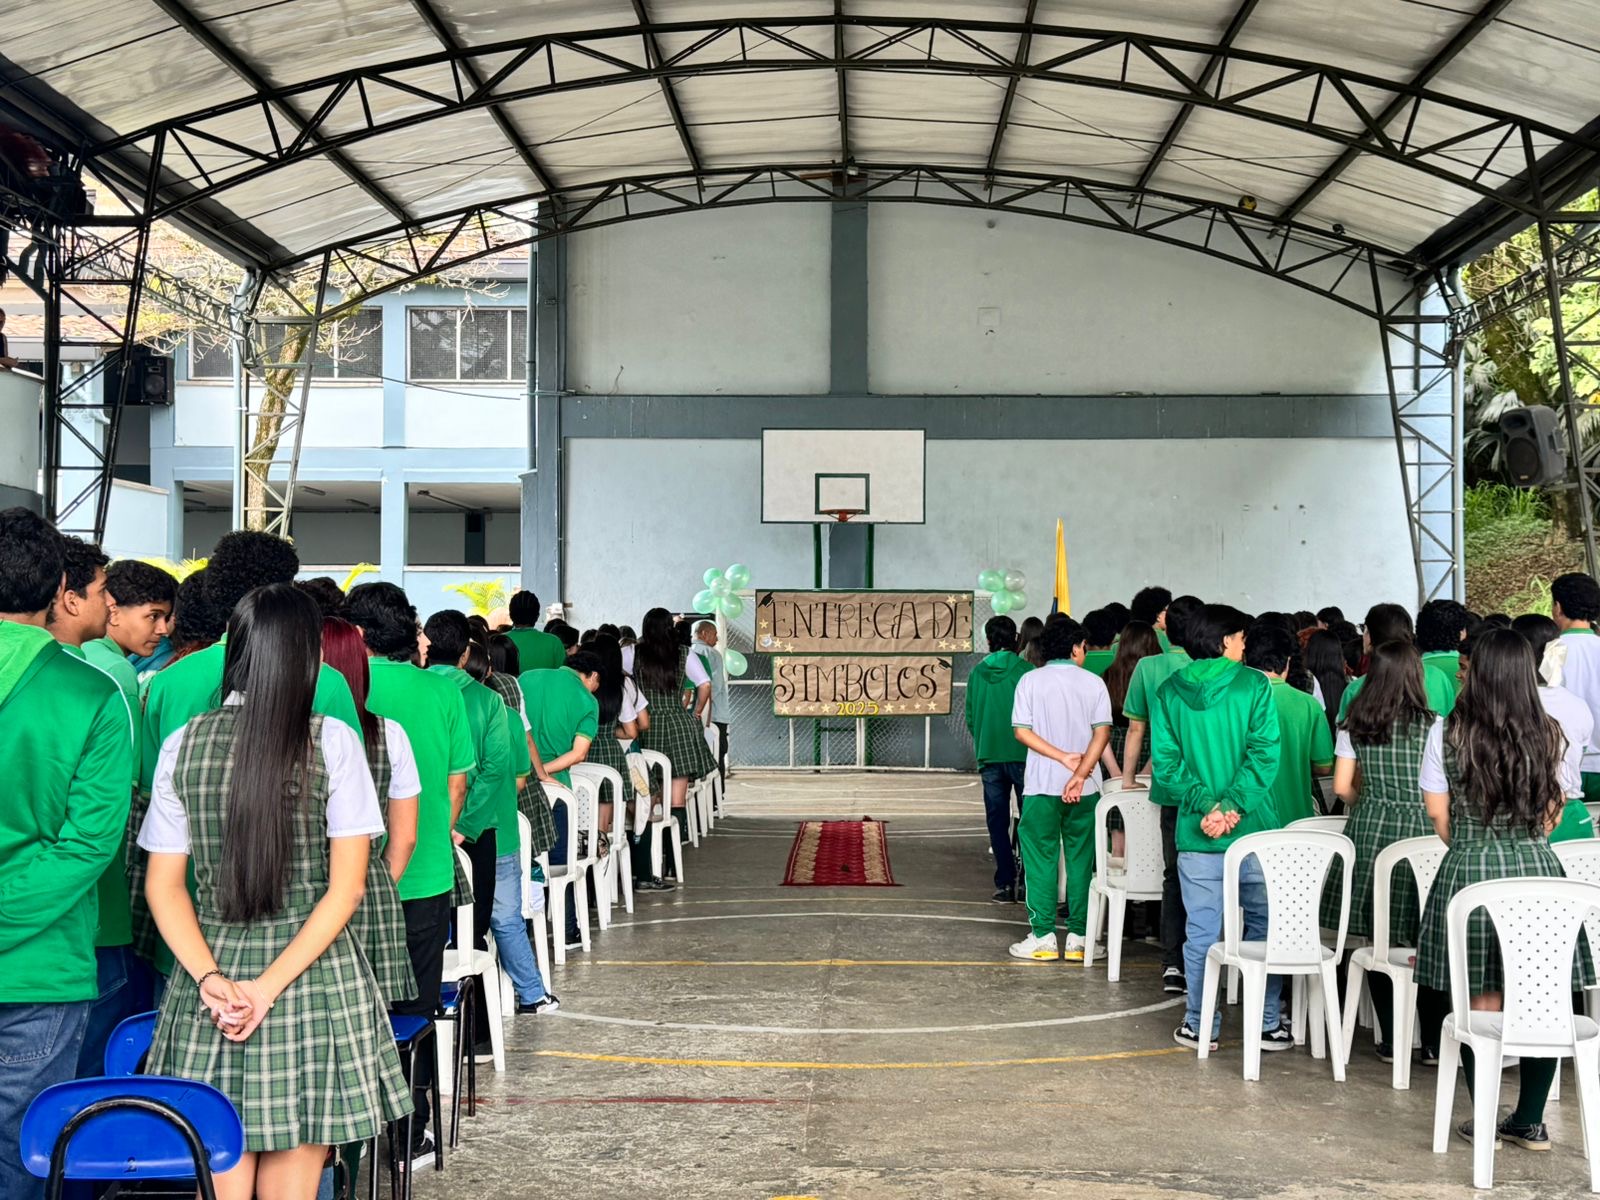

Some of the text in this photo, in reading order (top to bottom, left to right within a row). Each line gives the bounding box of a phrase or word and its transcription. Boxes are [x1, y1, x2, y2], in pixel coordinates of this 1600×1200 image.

[772, 601, 973, 639] ENTREGA DE
[773, 663, 937, 703] SIMBOLOS
[836, 702, 880, 716] 2025
